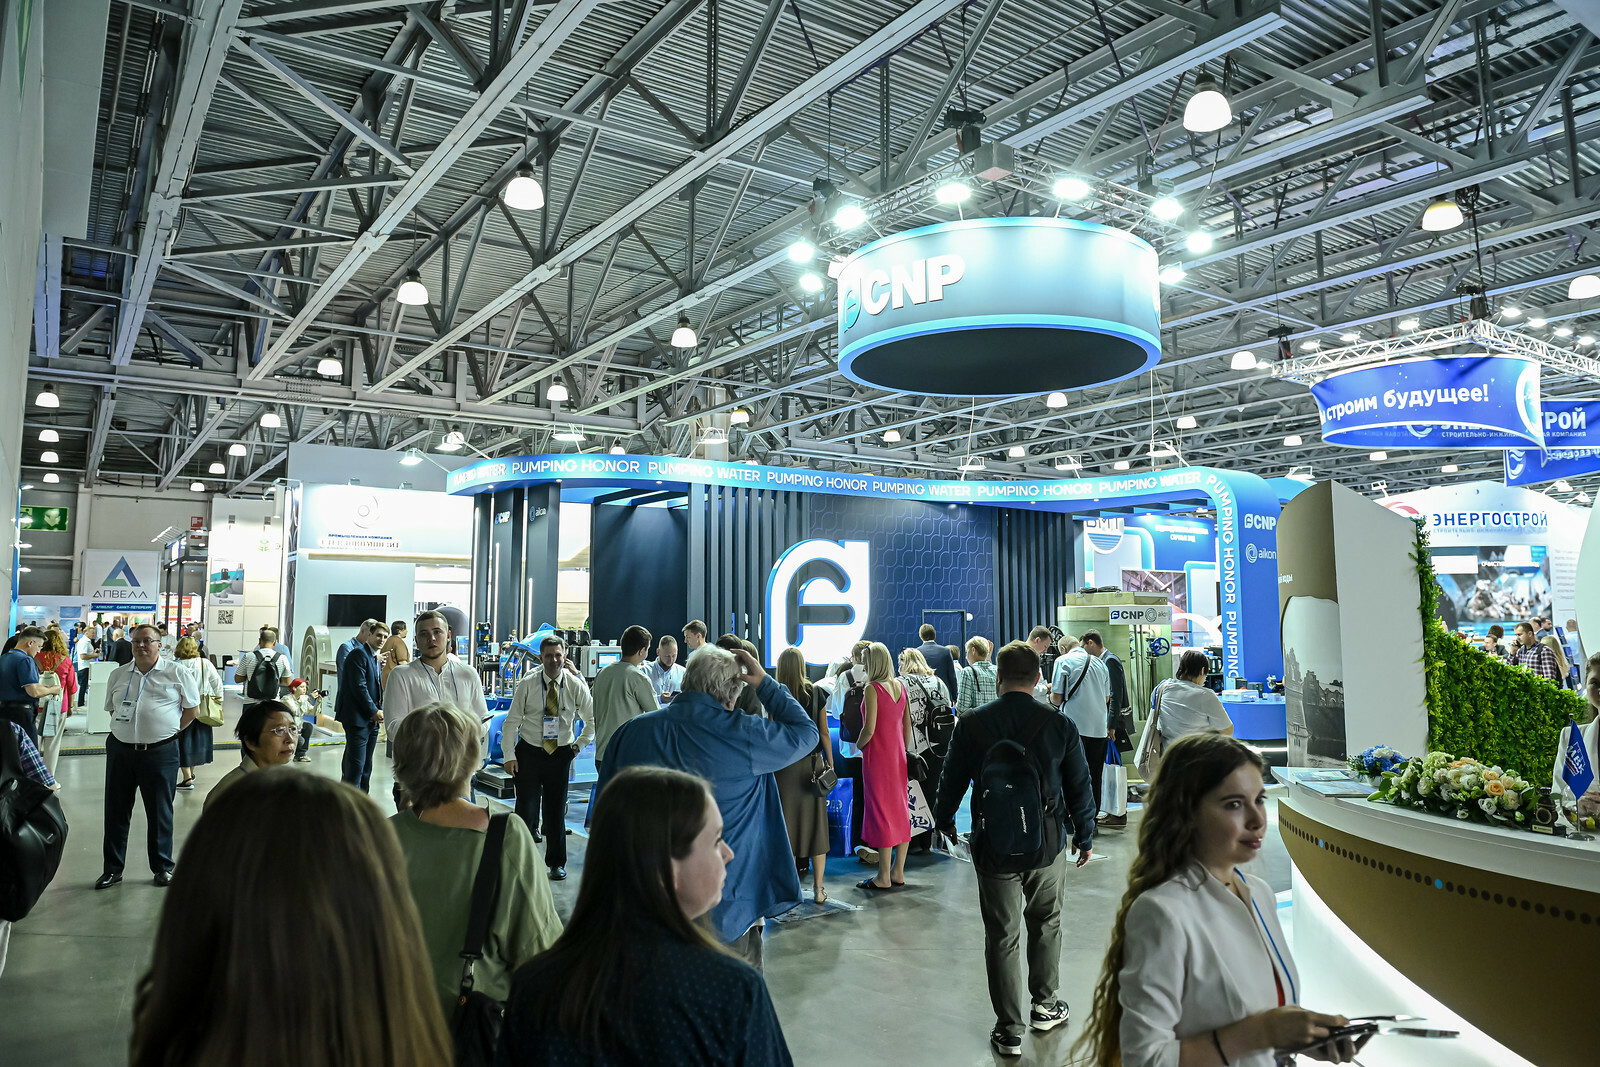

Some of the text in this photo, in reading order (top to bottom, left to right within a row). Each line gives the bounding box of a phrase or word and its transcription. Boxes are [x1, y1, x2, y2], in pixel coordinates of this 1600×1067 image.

[863, 254, 965, 316] CNP
[1327, 394, 1377, 421] строим
[1384, 384, 1489, 409] будущее!
[1541, 407, 1587, 430] РОЙ
[512, 459, 577, 474] PUMPING
[581, 459, 640, 474] HONOR
[648, 461, 714, 478] PUMPING
[717, 466, 760, 482] WATER
[767, 471, 823, 488] PUMPING
[826, 477, 867, 491] HONOR
[872, 481, 925, 496] PUMPING
[928, 485, 970, 497] WATER
[977, 485, 1040, 497] PUMPING
[1043, 483, 1092, 496] HONOR
[1099, 477, 1158, 493] PUMPING
[1160, 471, 1201, 487] WATER
[1254, 515, 1277, 531] CNP
[1433, 511, 1548, 527] ЭНЕРГОСТРОЙ
[1206, 473, 1234, 545] PUMPING
[1223, 548, 1236, 604] HONOR
[1259, 548, 1277, 560] aikon
[1120, 610, 1144, 620] CNP
